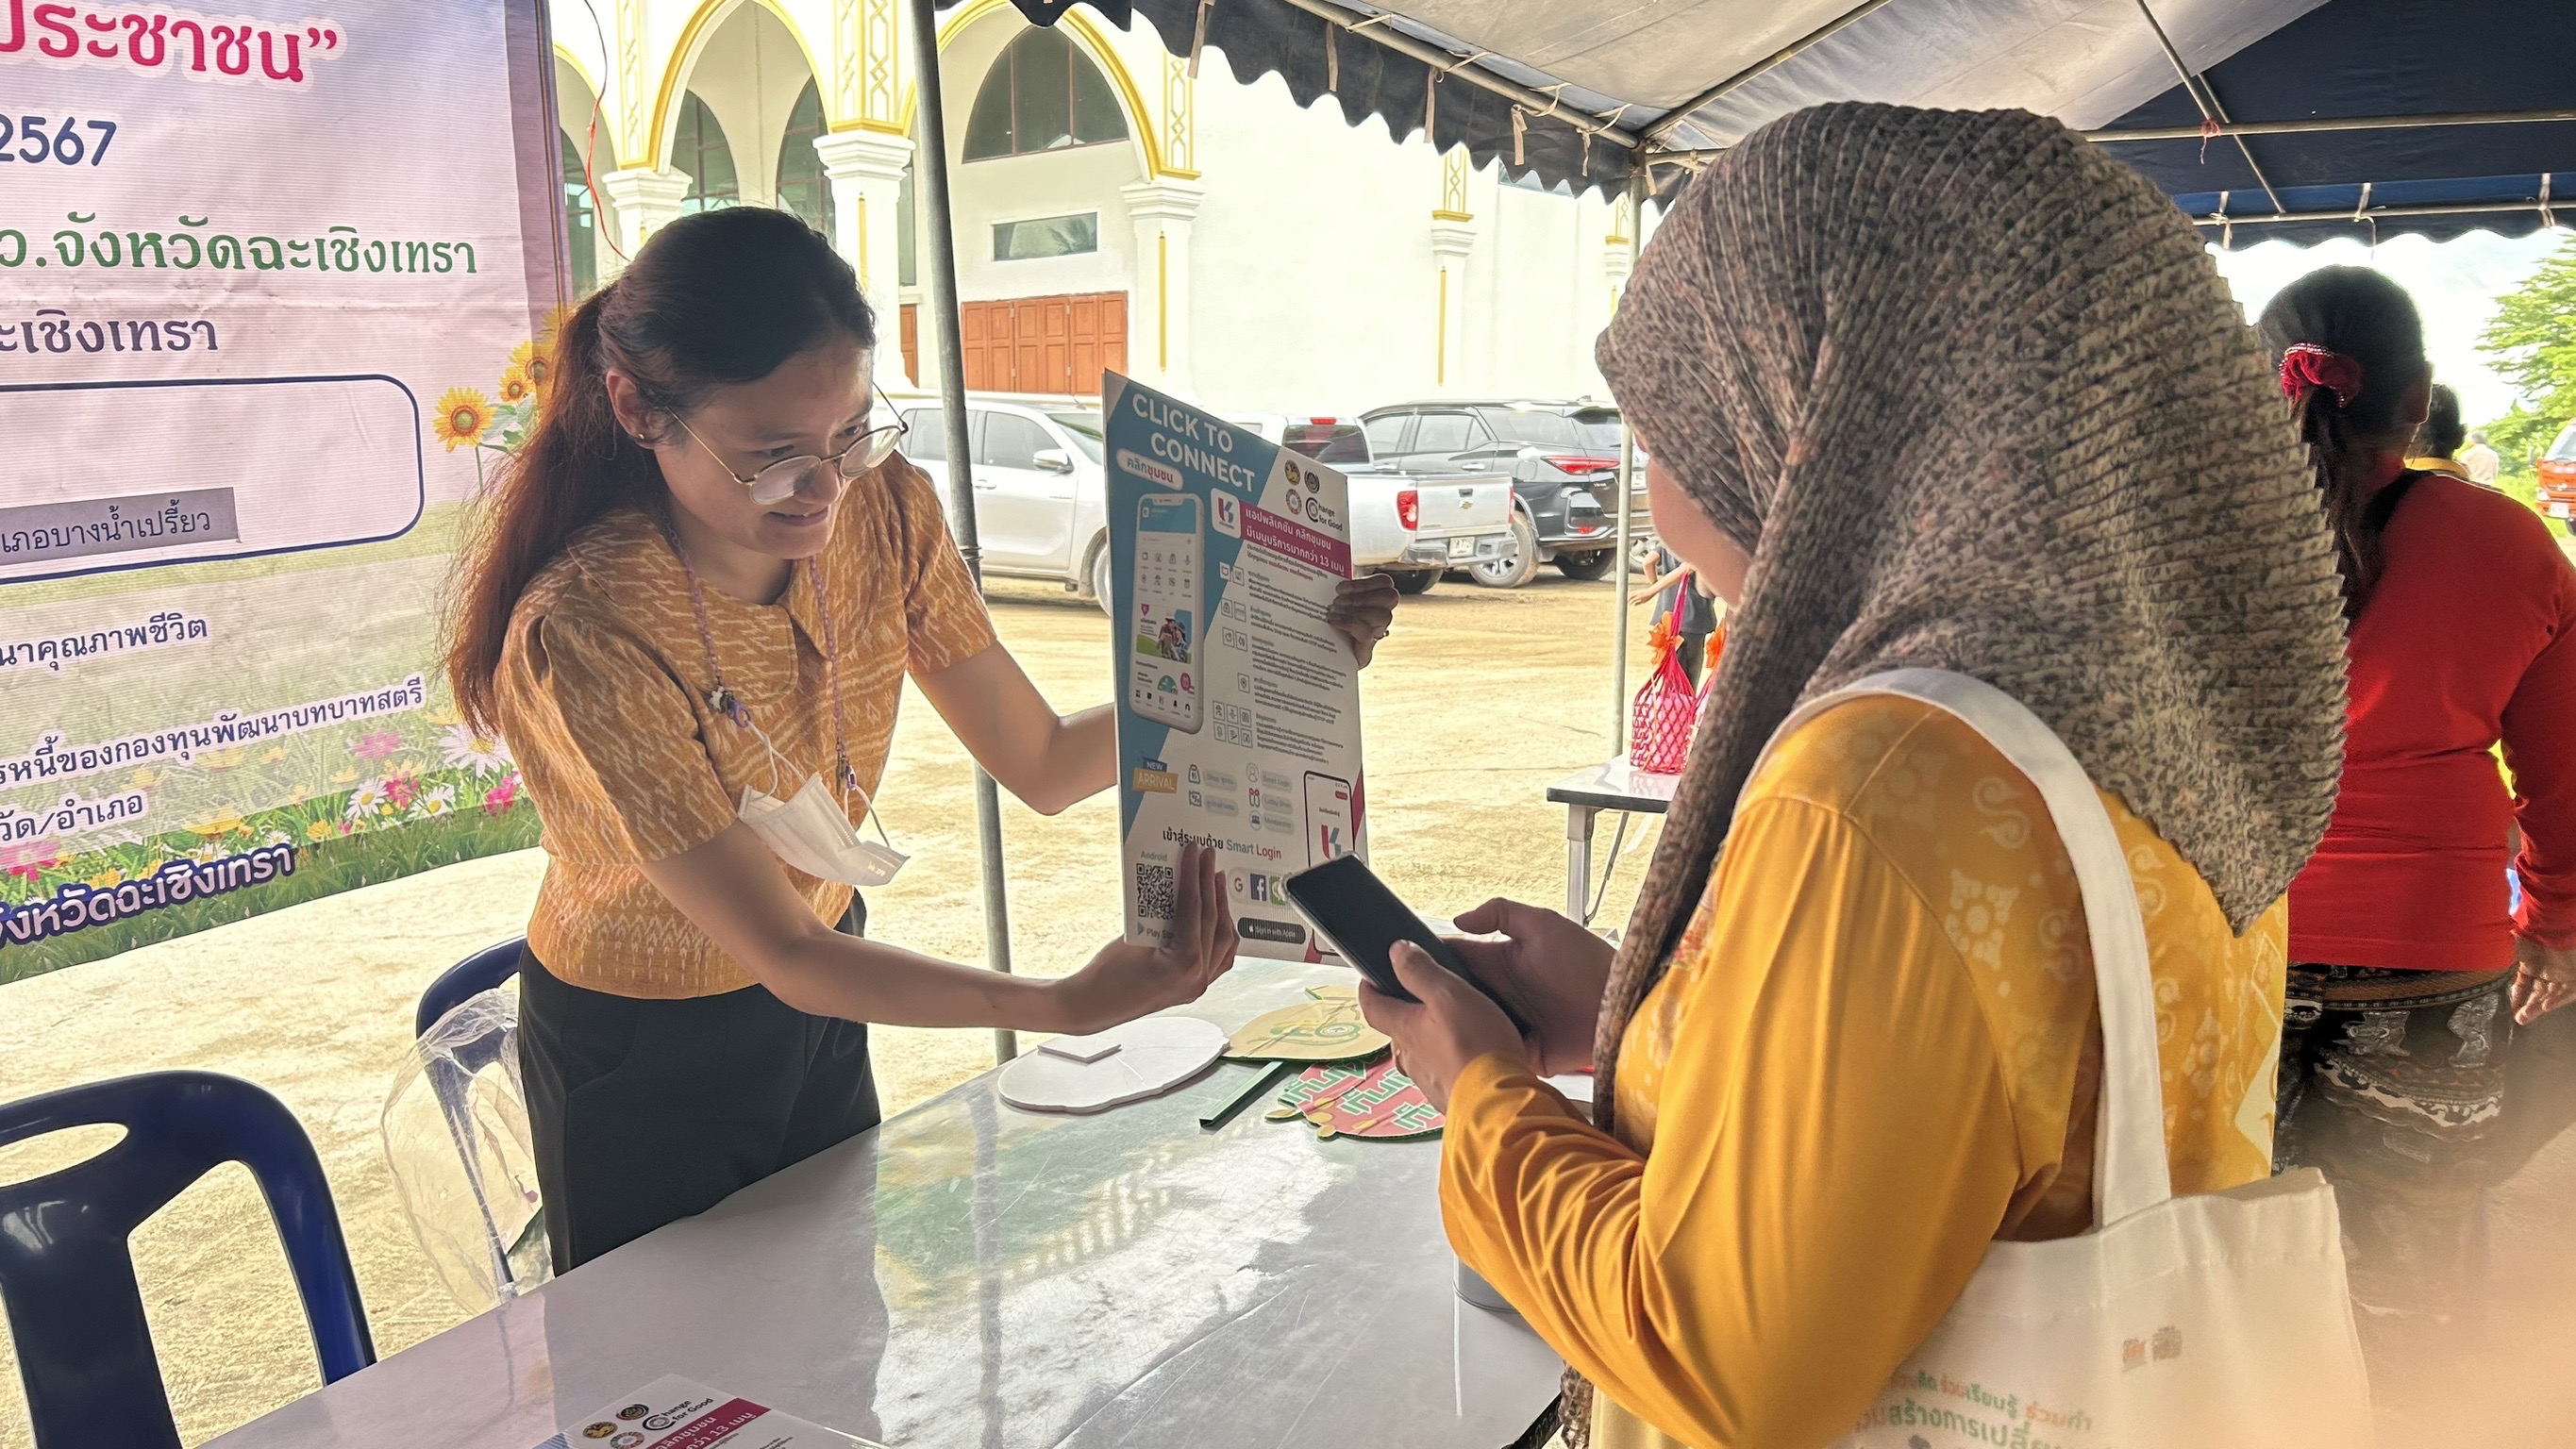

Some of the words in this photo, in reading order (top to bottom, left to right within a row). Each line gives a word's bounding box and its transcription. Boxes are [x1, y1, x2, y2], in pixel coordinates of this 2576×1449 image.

[0, 114, 117, 166] 2567
[1132, 393, 1199, 441] CLICK
[1204, 423, 1233, 453] TO
[1127, 458, 1174, 484] คลิกชุมชน
[1150, 432, 1255, 492] CONNECT
[1, 499, 211, 553] เภอบางน้ำเปรี้ยว
[1246, 509, 1294, 535] แอปพลิเคชัน
[1296, 527, 1331, 550] คลิกชุมชน
[1328, 519, 1343, 531] Good
[1320, 555, 1329, 568] 13
[0, 612, 208, 671] นาคุณภาพชีวิต
[1146, 761, 1163, 771] NEW
[1137, 772, 1176, 791] ARRIVAL
[1141, 851, 1167, 862] Android
[1227, 839, 1254, 855] Smart
[1256, 845, 1281, 860] Login
[0, 844, 294, 941] งหวัดฉะเชิงเทรา
[688, 1398, 713, 1413] Good
[710, 1425, 729, 1437] 13
